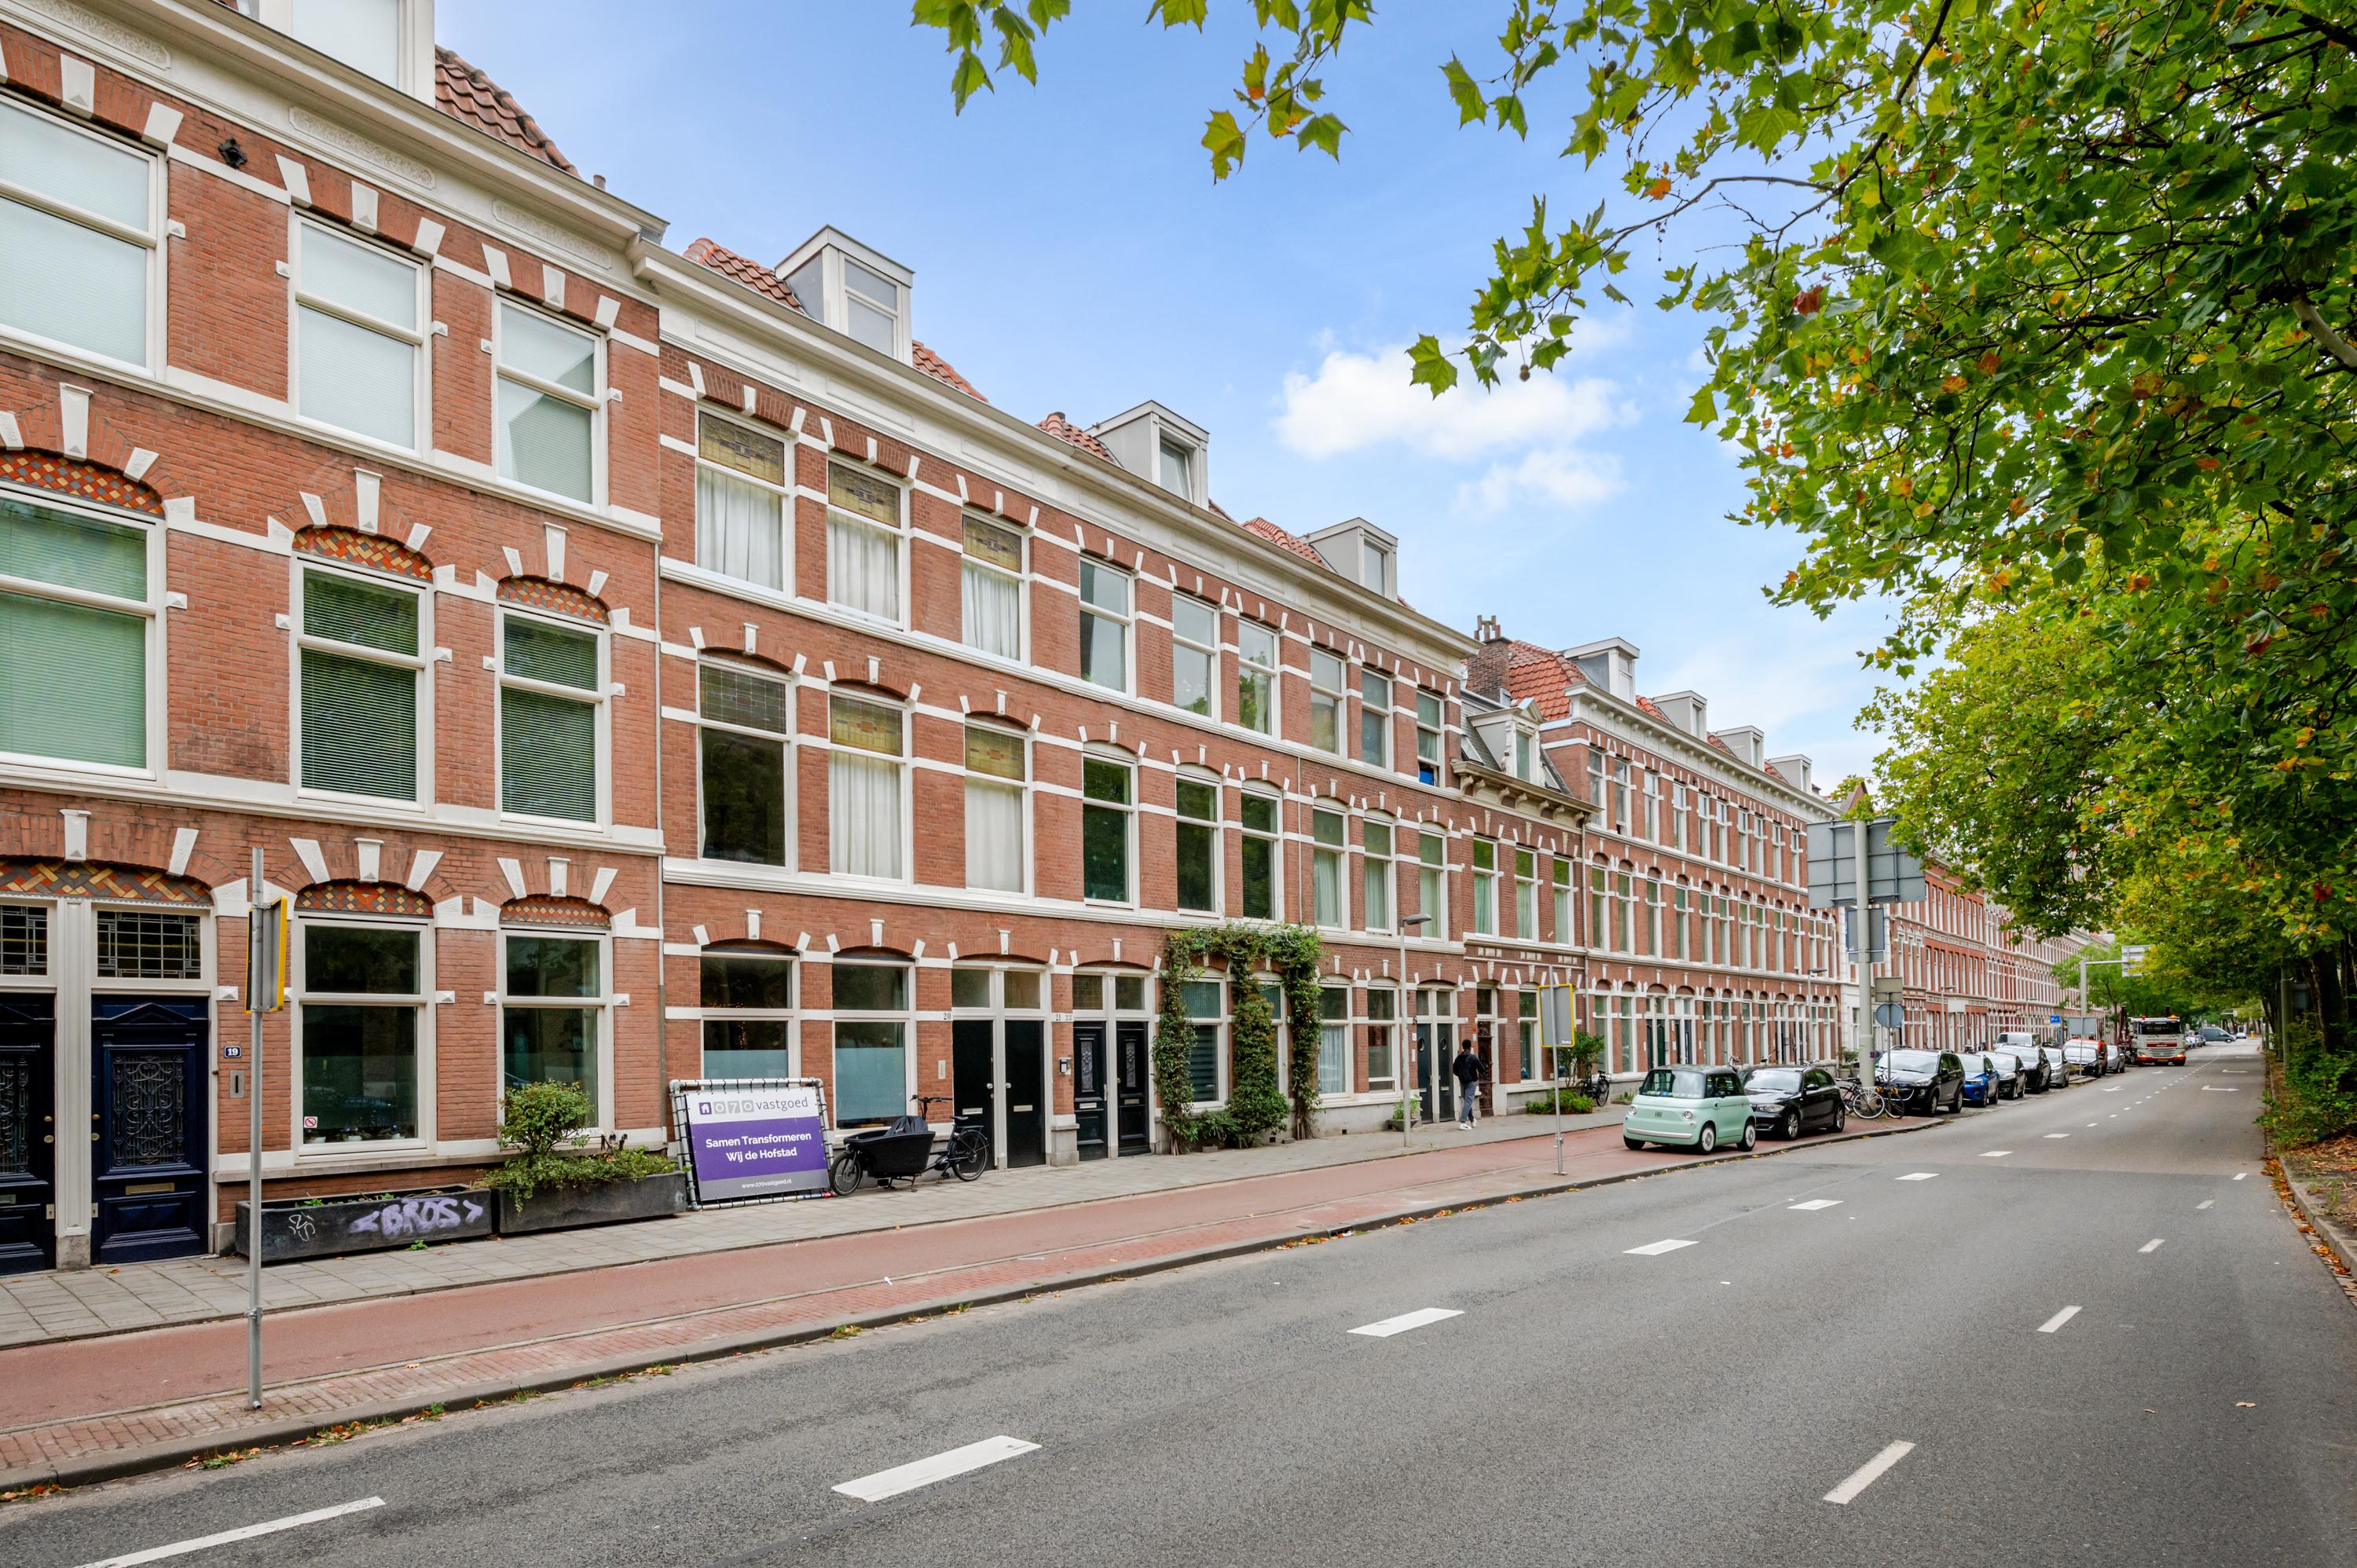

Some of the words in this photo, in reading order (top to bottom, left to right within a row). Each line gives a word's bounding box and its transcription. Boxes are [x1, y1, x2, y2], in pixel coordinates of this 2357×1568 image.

[756, 1096, 808, 1112] vastgoed
[706, 1138, 741, 1148] Samen
[742, 1133, 812, 1145] Transformeren
[726, 1151, 743, 1163] Wij
[745, 1151, 758, 1160] de
[760, 1147, 798, 1159] Hofstad
[742, 1178, 793, 1188] www.070vastgoed.nl
